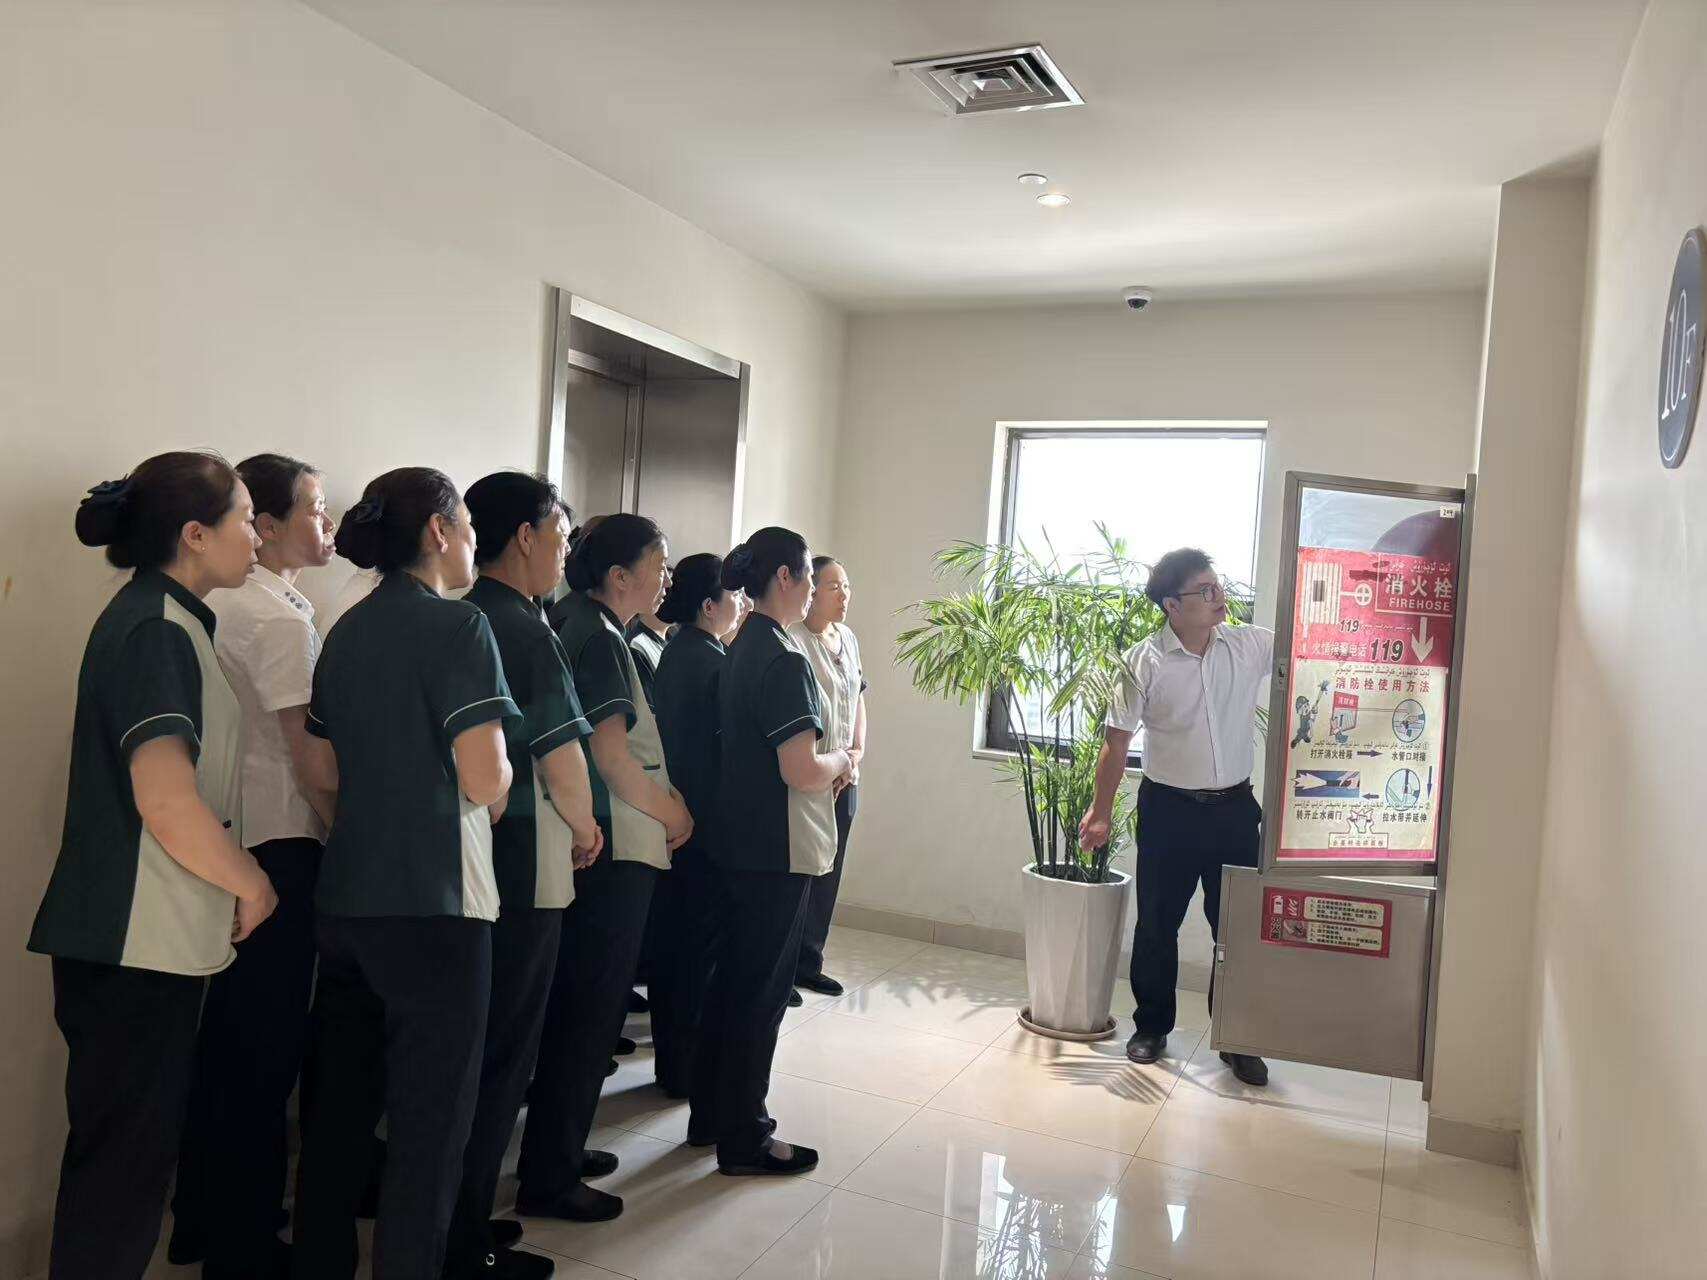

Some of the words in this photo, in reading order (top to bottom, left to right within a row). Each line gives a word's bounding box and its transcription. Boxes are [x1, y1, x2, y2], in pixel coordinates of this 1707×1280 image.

[1384, 573, 1453, 599] 消火栓
[1389, 597, 1451, 611] FIREHOSE
[1339, 619, 1360, 632] 119
[1370, 637, 1405, 662] 119
[1335, 677, 1430, 693] 消防栓使用方法
